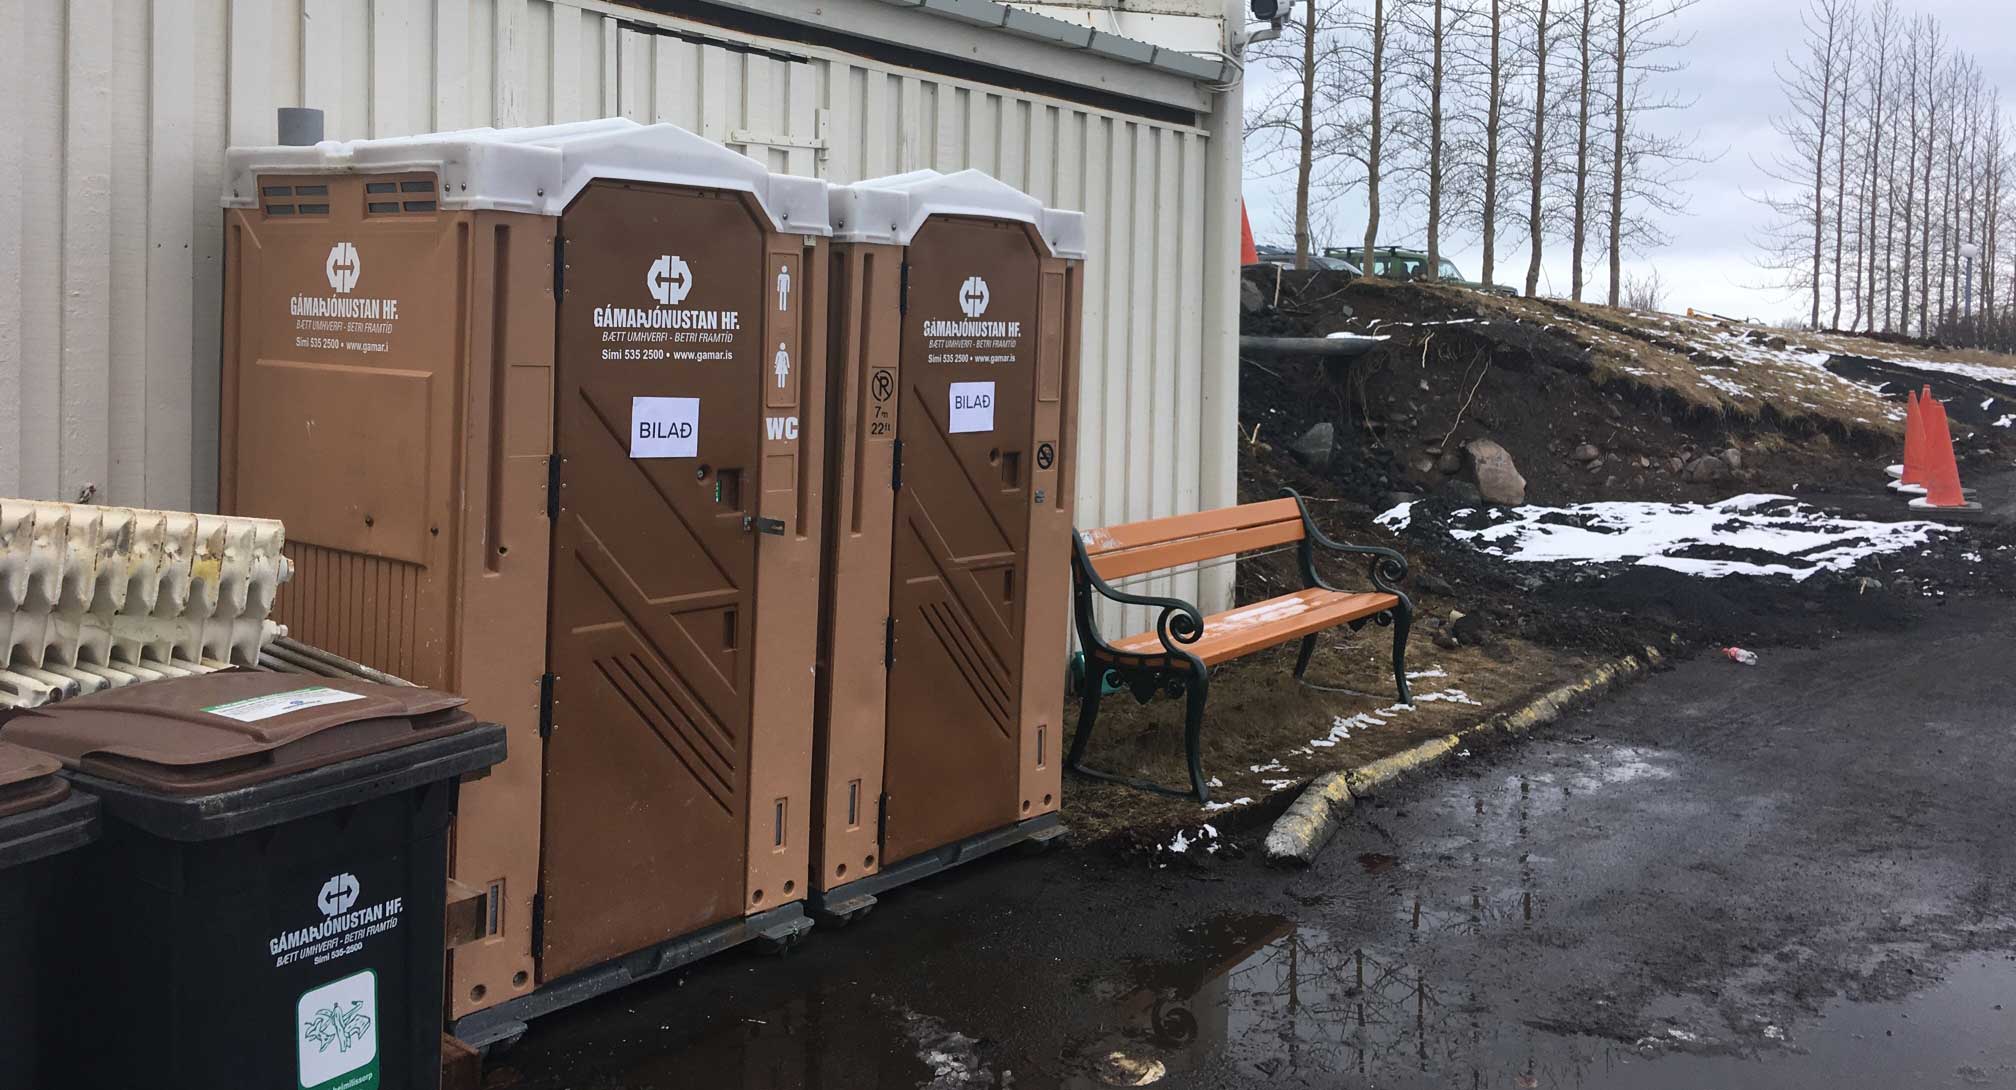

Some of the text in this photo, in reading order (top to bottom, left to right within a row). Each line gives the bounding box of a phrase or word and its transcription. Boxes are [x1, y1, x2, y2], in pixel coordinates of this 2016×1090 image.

[291, 293, 398, 319] GÁMAÞJÓNUSTAN HF.
[594, 304, 740, 329] GÁMAÞJÓNUSTAN HF.
[602, 331, 626, 342] BÆTT
[627, 331, 668, 342] UMHVERFI
[674, 332, 698, 343] BETRI
[1009, 322, 1021, 337] HF.
[310, 337, 321, 348] 535
[323, 338, 339, 349] 2500
[624, 349, 641, 360] 535
[642, 349, 664, 360] 2500
[673, 349, 733, 362] www.gamar.is
[943, 353, 954, 363] 535
[954, 353, 969, 363] 2500
[955, 394, 991, 410] BILAÐ
[639, 422, 692, 439] BILAÐ
[766, 416, 799, 440] WC
[270, 897, 403, 955] GÁMAÞJÓNUSTAN HF.
